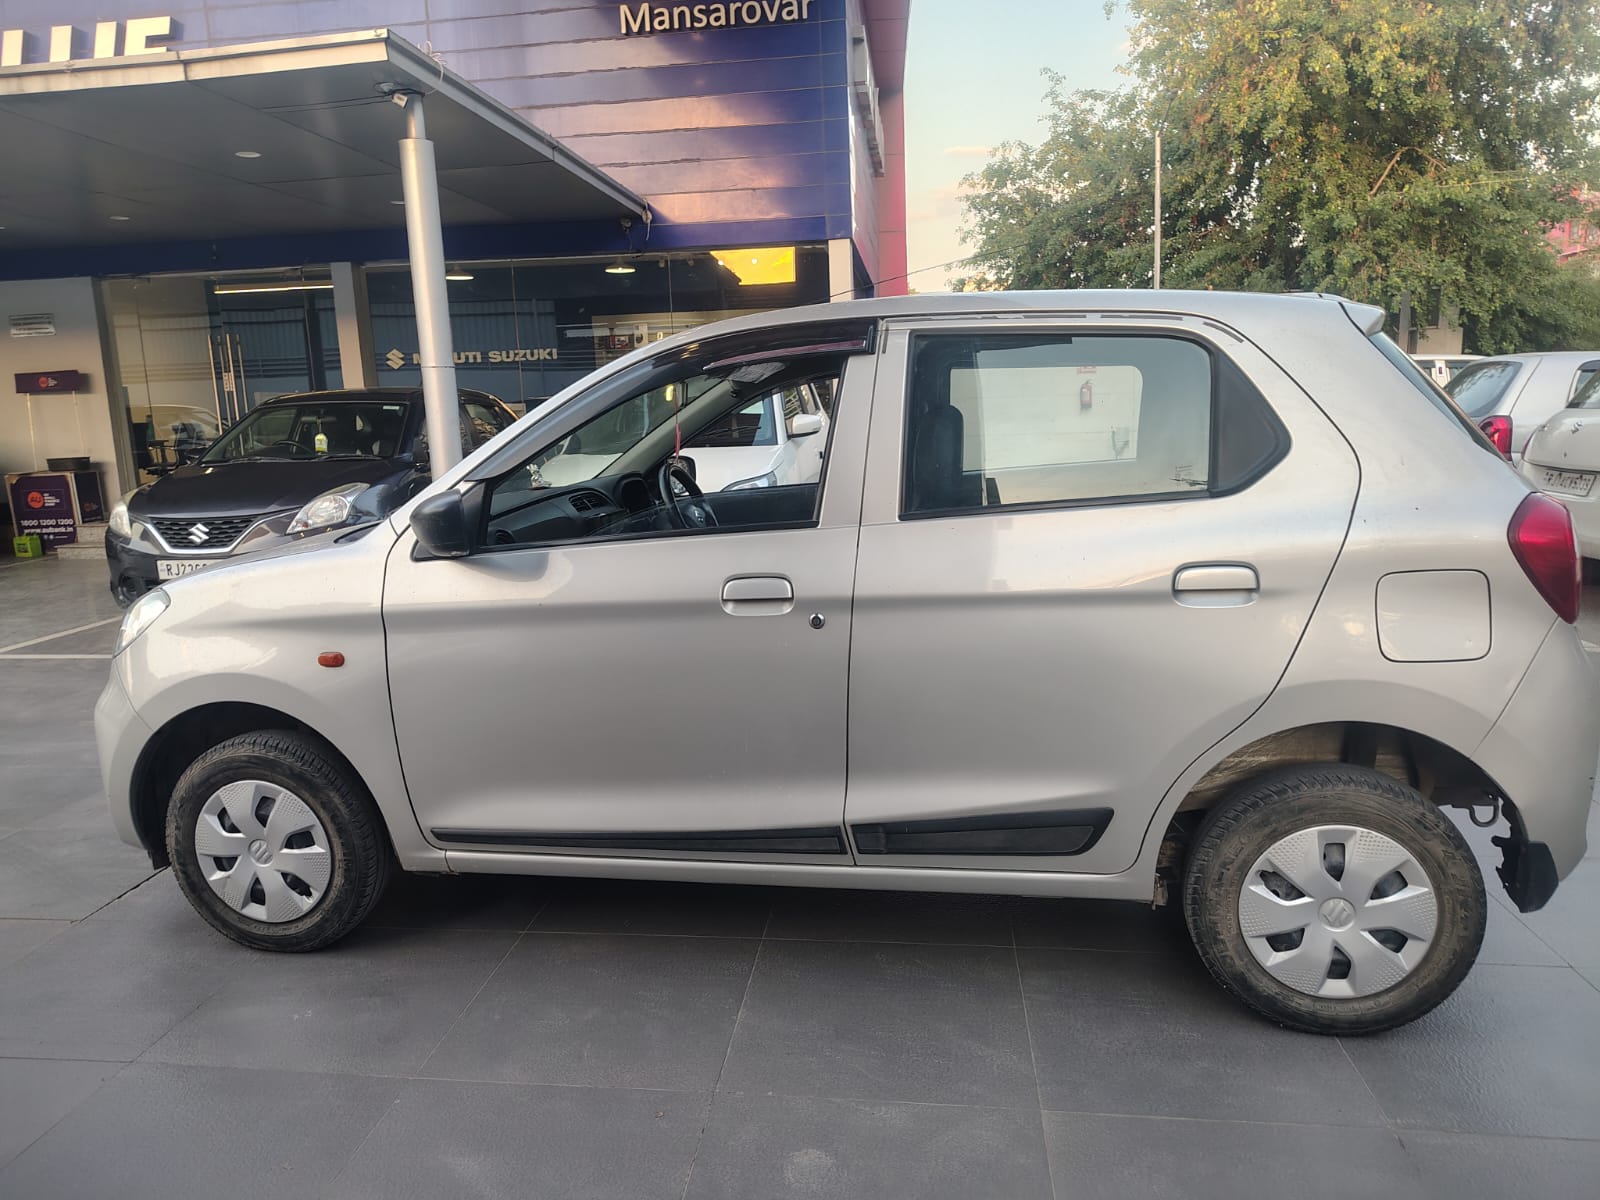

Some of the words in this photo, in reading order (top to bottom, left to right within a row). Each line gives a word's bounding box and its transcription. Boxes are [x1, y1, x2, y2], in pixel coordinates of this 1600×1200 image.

[619, 0, 813, 34] Mansarovar
[413, 352, 482, 365] MUTI
[488, 348, 558, 363] SUZUKI
[39, 518, 57, 526] 1200
